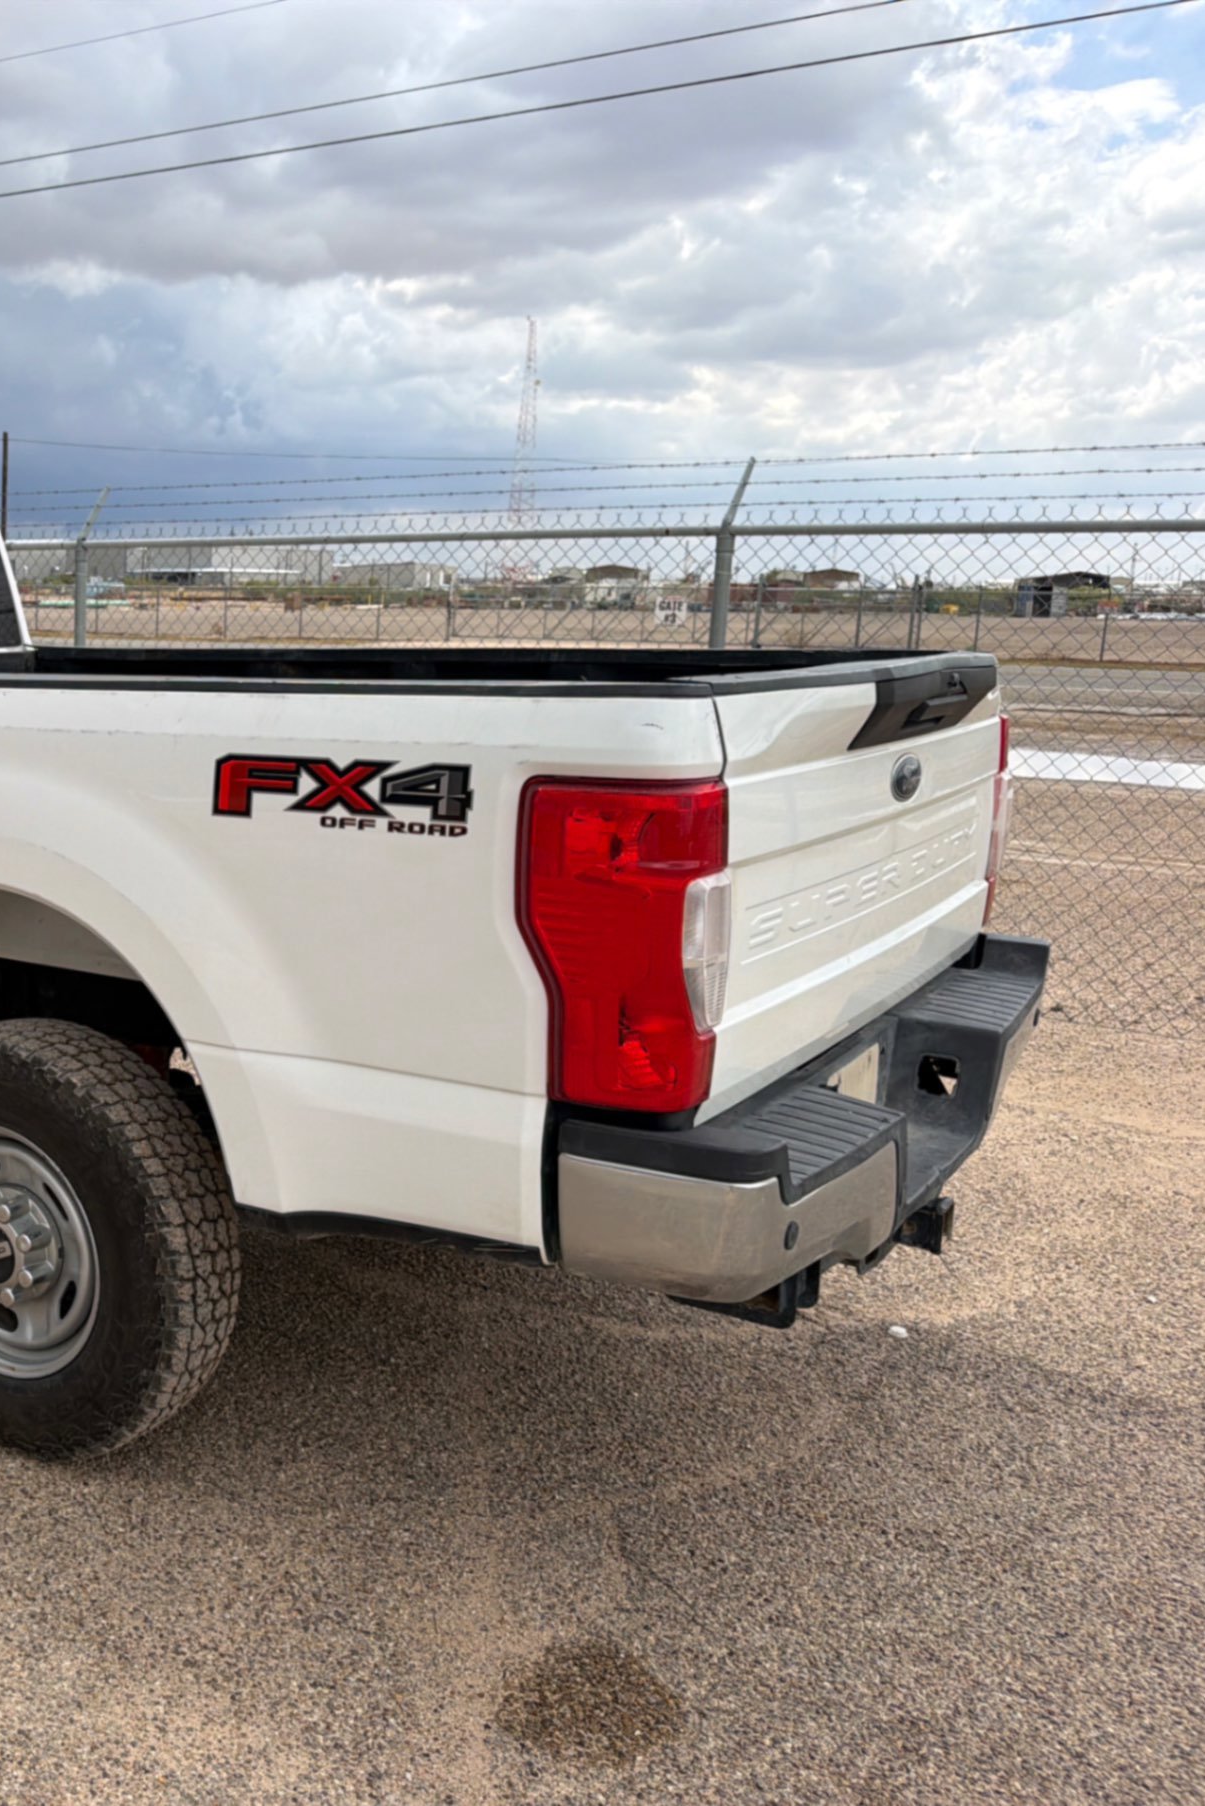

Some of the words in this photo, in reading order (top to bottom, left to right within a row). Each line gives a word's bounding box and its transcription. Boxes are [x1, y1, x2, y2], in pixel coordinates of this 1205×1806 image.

[659, 600, 683, 612] GATE
[212, 752, 474, 823] FX4
[320, 815, 377, 830] OFF
[387, 820, 469, 838] ROAD
[748, 862, 900, 950] SUPER
